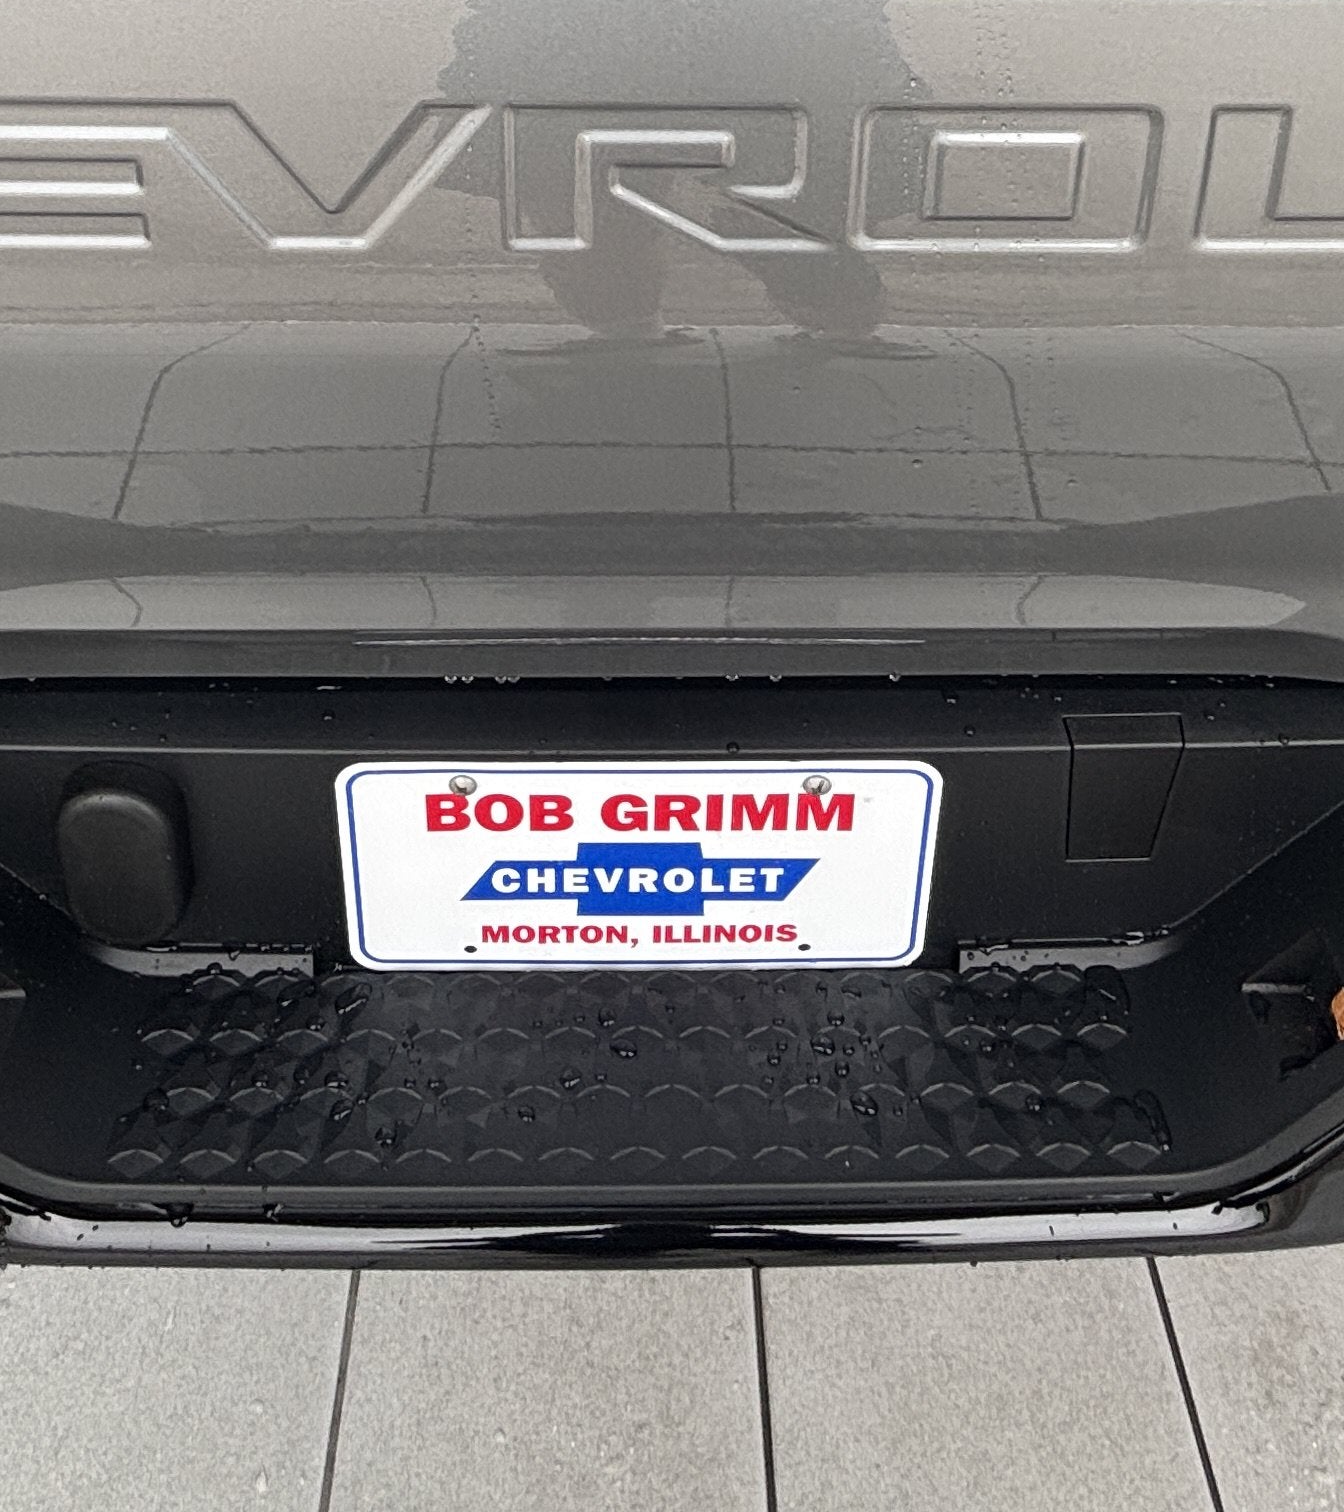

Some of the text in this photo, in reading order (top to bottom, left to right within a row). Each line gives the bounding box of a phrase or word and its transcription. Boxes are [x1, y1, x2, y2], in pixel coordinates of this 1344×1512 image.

[424, 793, 856, 833] BOB GRIMM
[490, 866, 786, 894] CHEVROLET
[481, 923, 799, 948] MORTON, ILLINOIS
